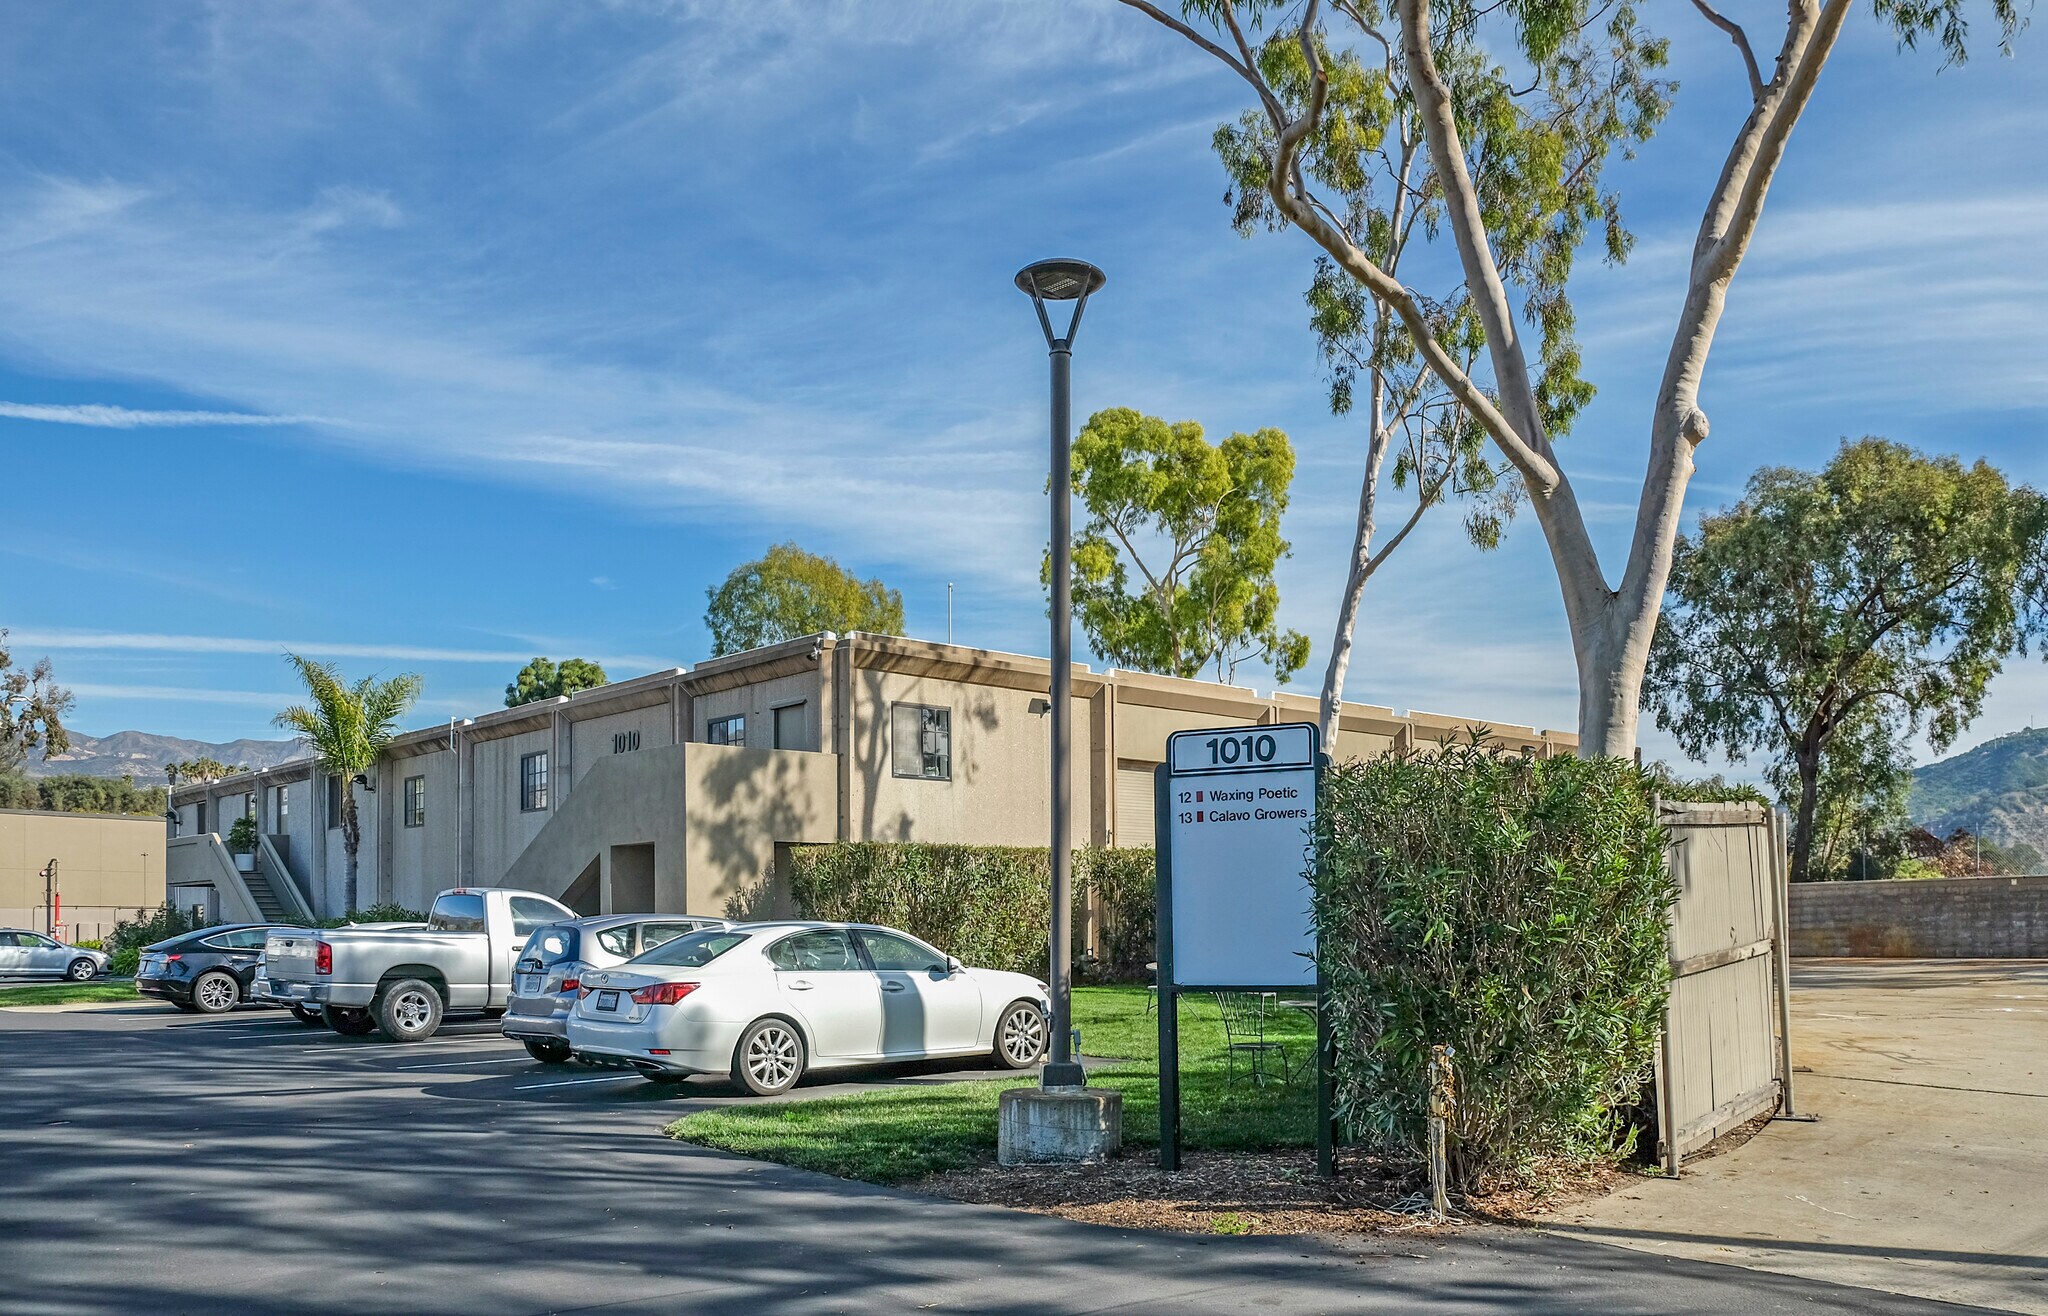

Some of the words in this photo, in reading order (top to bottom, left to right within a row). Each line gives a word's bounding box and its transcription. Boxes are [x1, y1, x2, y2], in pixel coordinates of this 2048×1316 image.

[611, 730, 640, 754] 1010
[1206, 734, 1276, 764] 1010
[1178, 792, 1192, 803] 12
[1209, 789, 1253, 802] Waxing
[1258, 787, 1298, 799] Poetic
[1179, 812, 1193, 824] 13
[1209, 810, 1250, 822] Calavo
[1254, 808, 1307, 820] Growers
